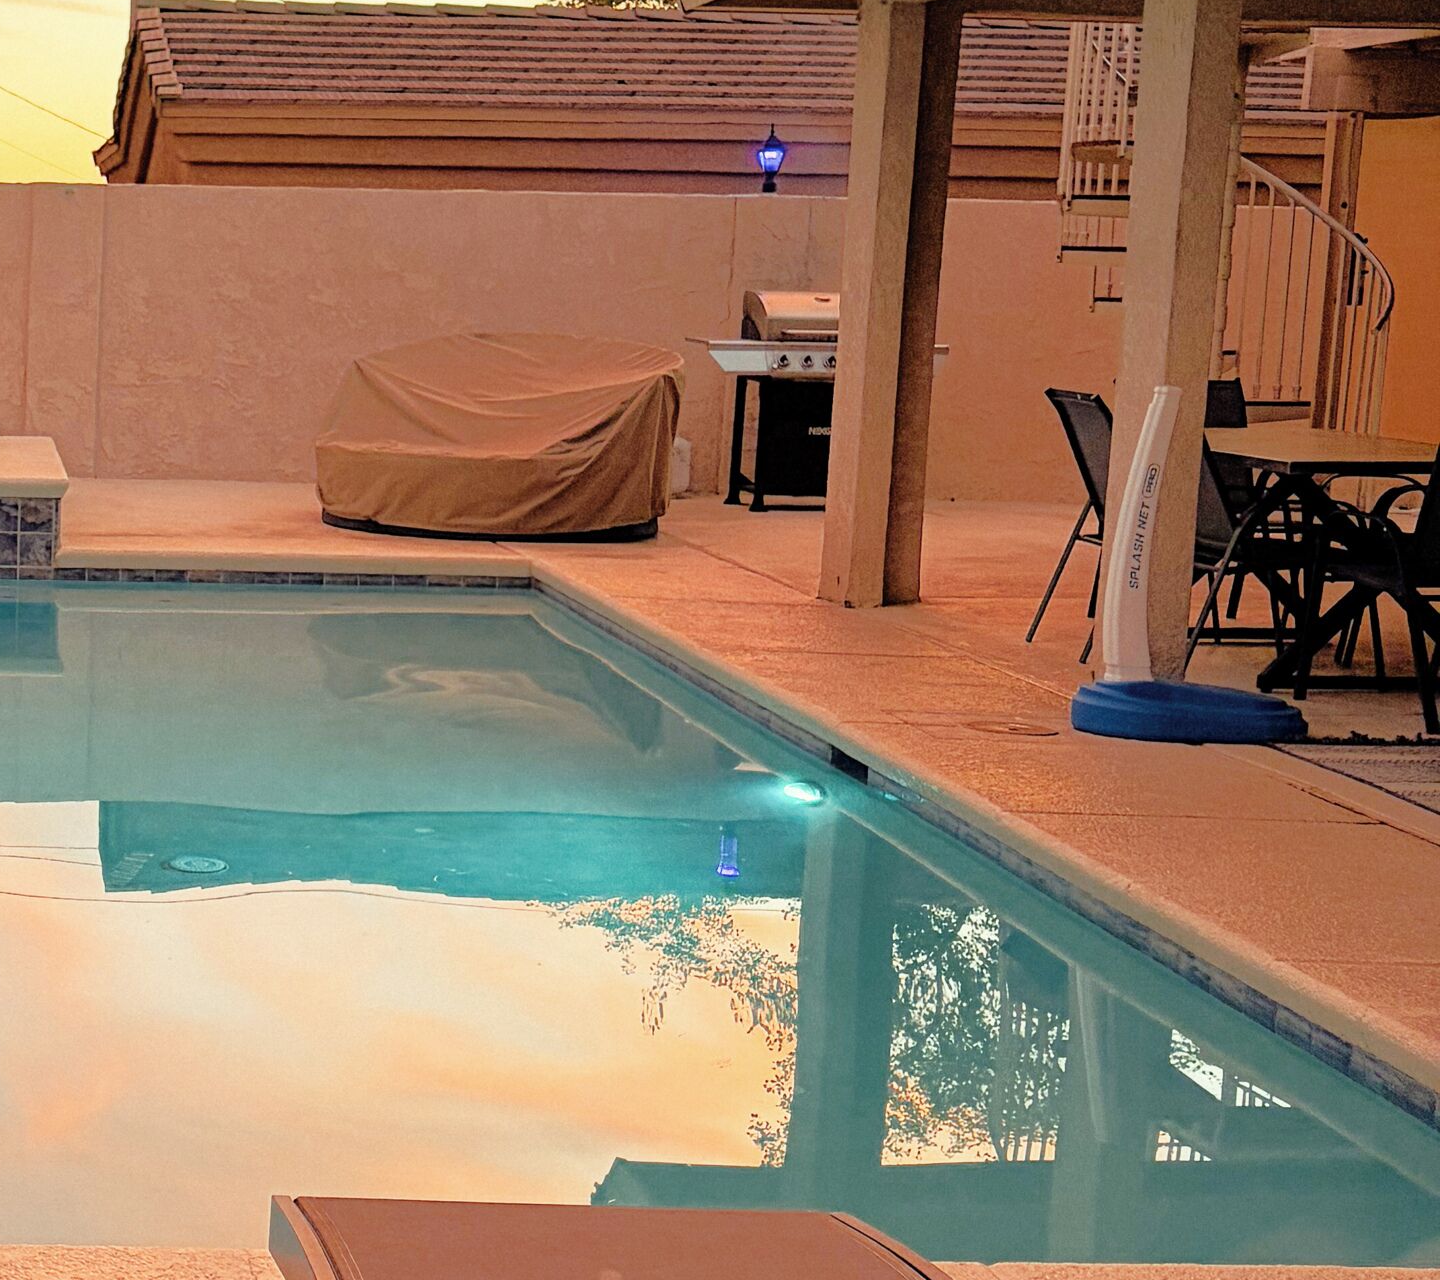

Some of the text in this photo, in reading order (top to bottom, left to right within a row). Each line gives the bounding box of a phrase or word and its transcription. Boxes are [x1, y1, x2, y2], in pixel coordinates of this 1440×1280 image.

[1129, 467, 1158, 589] SPLASH NET PRO
